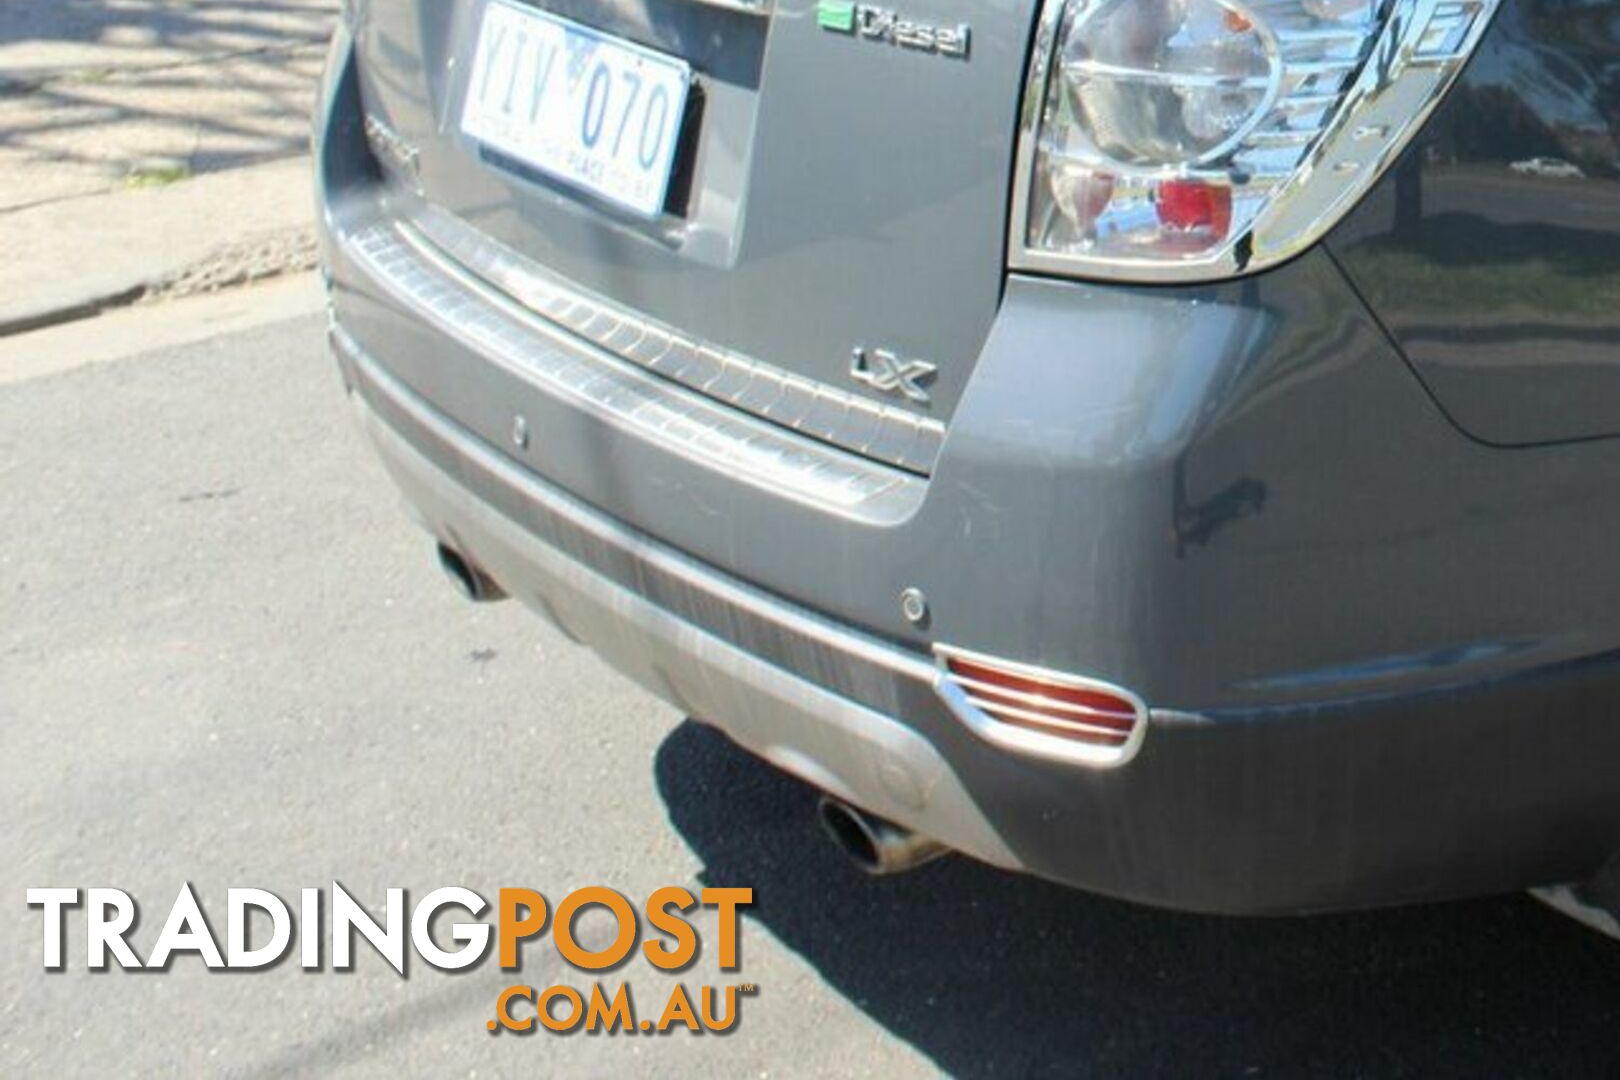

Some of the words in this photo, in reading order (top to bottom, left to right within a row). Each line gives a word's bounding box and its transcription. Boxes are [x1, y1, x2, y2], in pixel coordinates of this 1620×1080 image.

[856, 3, 971, 59] Diesel
[581, 60, 669, 170] 070
[851, 347, 937, 400] LX
